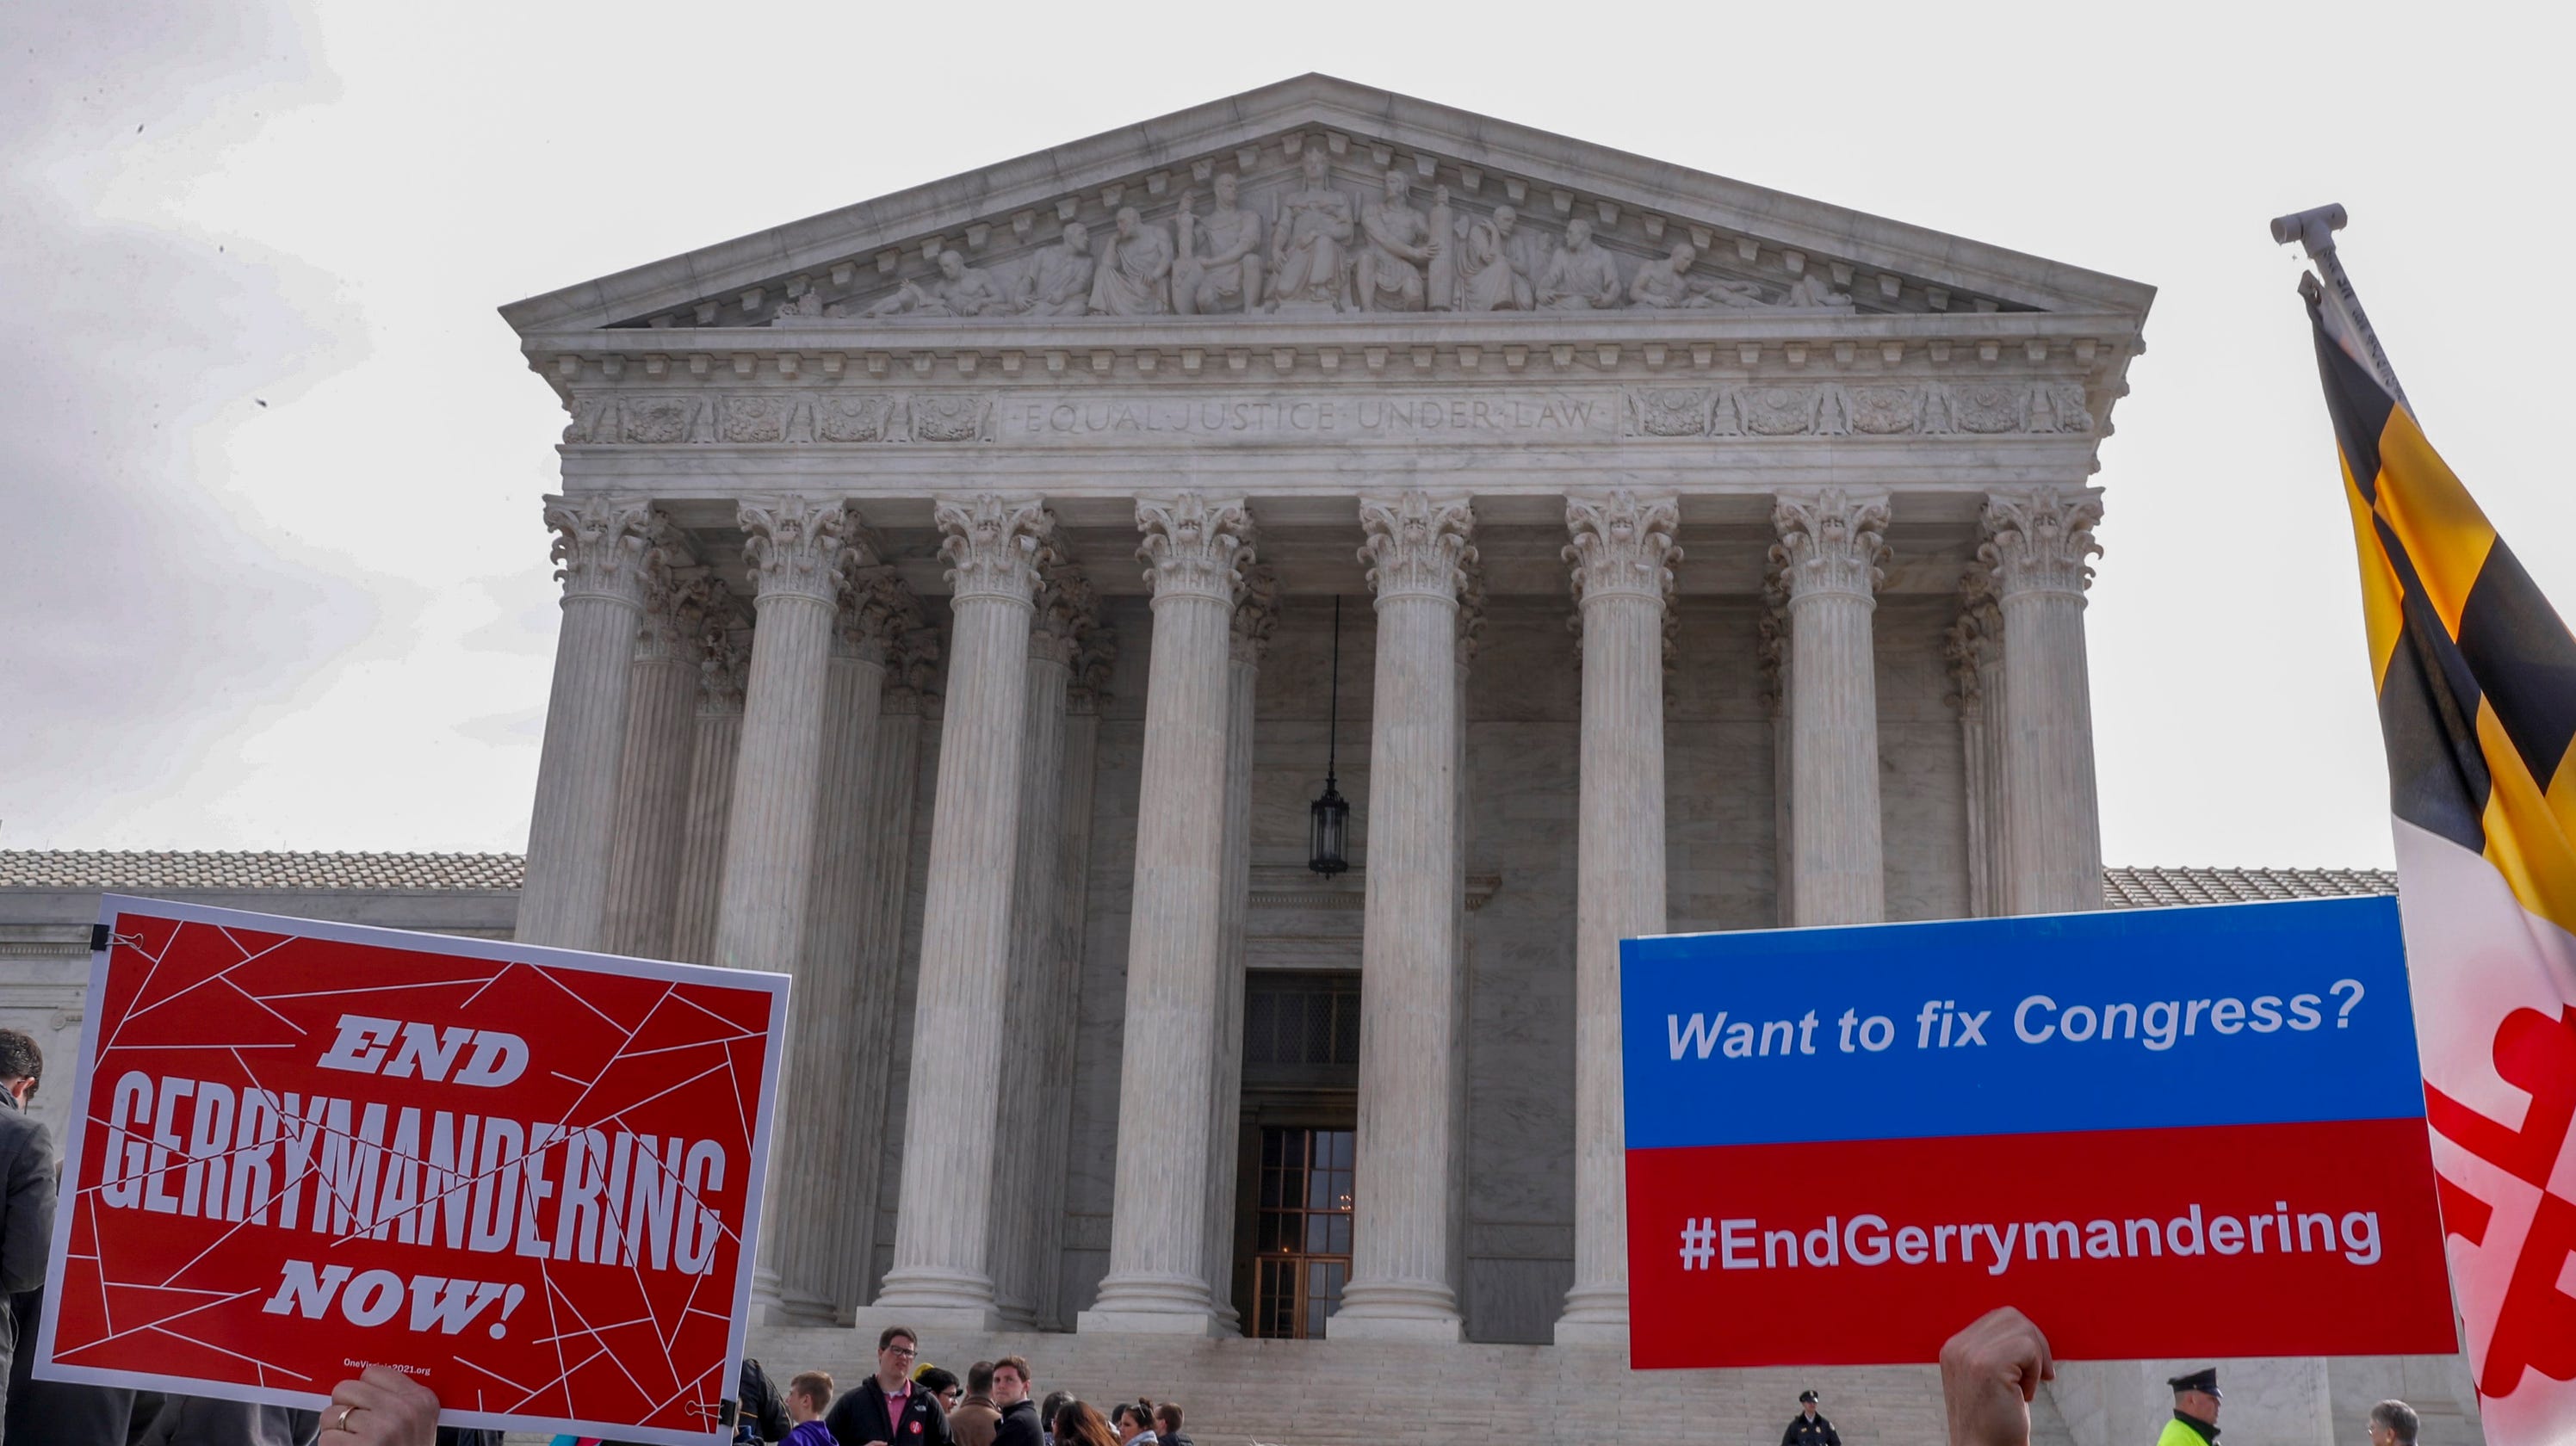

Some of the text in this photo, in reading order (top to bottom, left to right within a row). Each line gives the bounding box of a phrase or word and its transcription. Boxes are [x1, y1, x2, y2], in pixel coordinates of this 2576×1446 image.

[1025, 399, 1593, 434] EQUAL JUSTICE UNDER LAW
[316, 1014, 529, 1087] END
[1667, 978, 2365, 1060] Want to fix Congress?
[102, 1071, 726, 1276] GERRYMANDERING
[1679, 1201, 2381, 1275] #EndGerrymandering
[263, 1259, 525, 1339] NOW!
